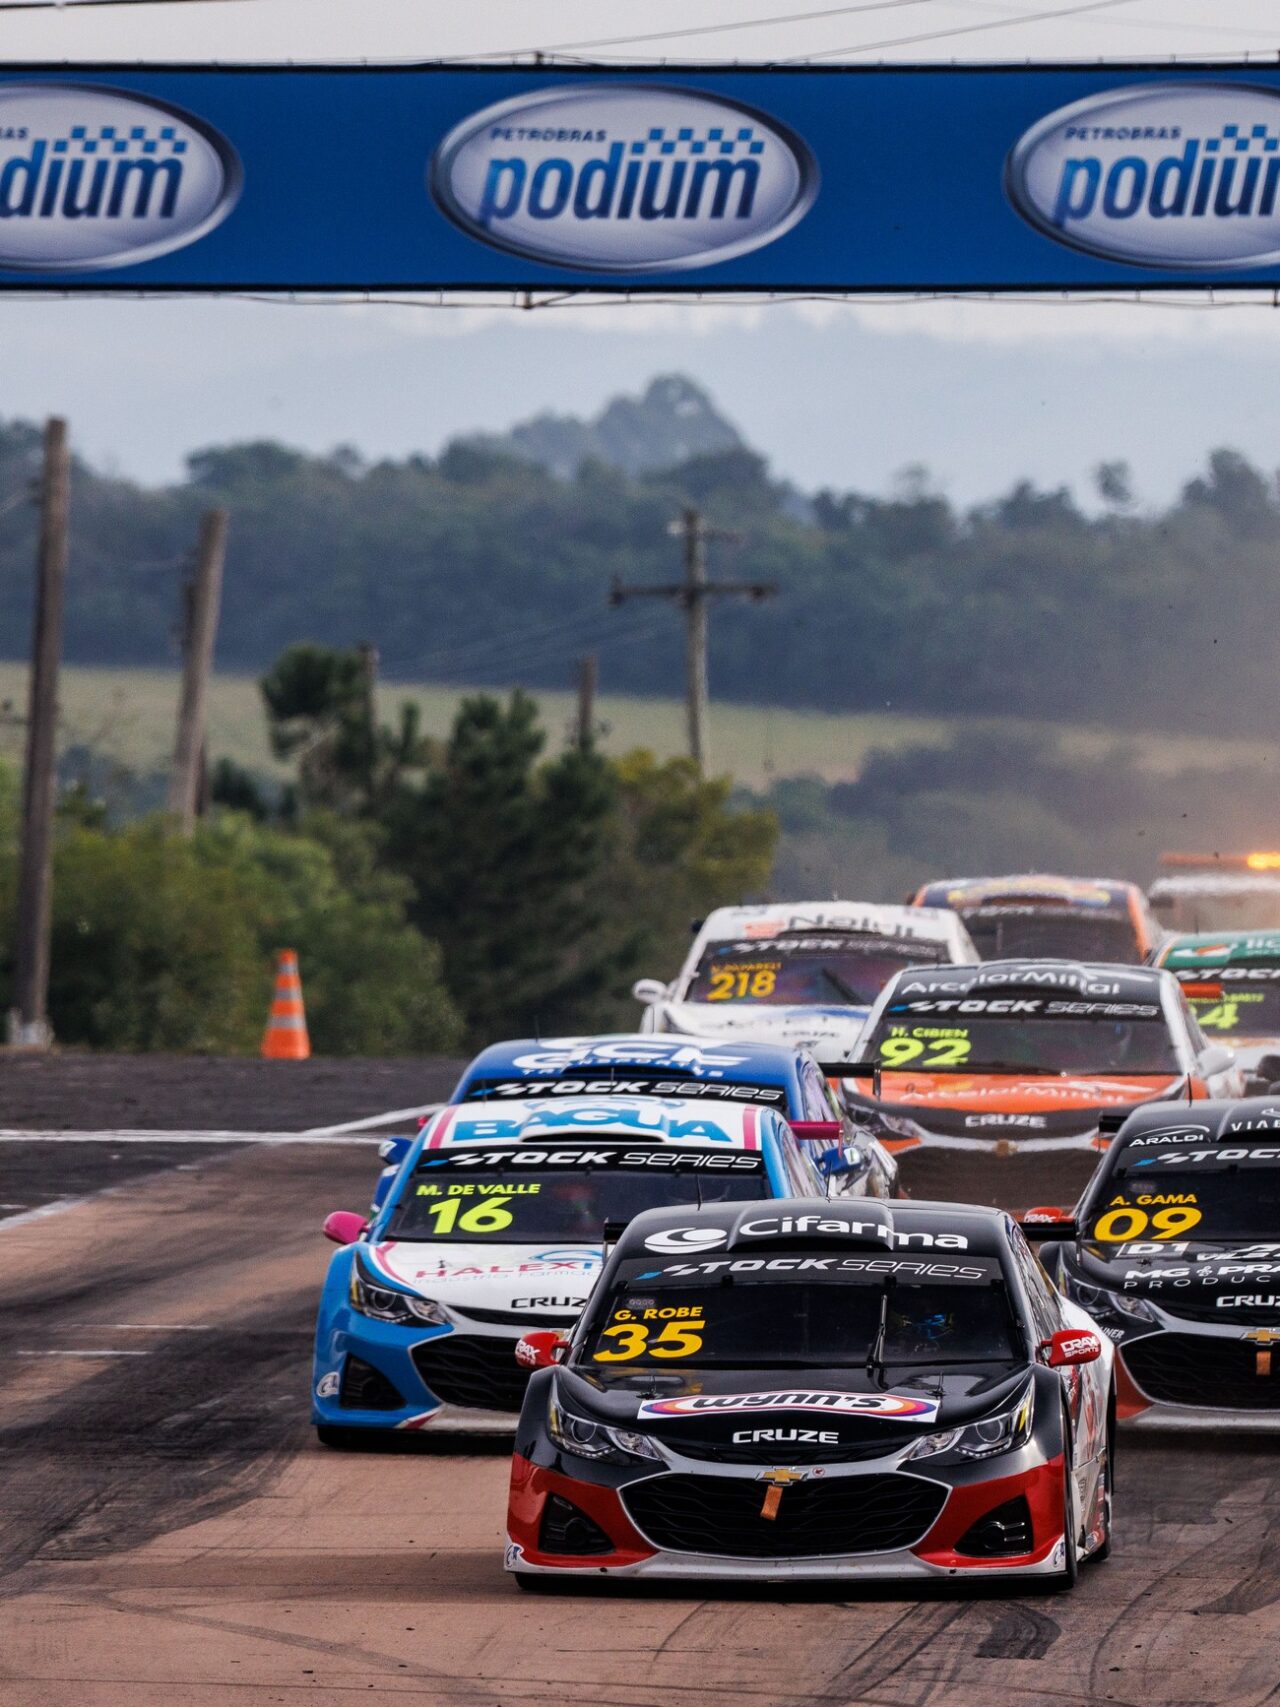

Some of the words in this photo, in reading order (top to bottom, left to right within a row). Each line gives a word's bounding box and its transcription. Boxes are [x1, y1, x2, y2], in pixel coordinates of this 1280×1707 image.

[491, 127, 606, 143] PETROBRAS
[1065, 126, 1181, 141] PETROBRAS
[0, 140, 186, 219] dium
[478, 141, 758, 226] podium
[706, 970, 777, 1000] 218
[902, 971, 1121, 996] ArcelorMittal
[889, 999, 1042, 1014] STOCK
[891, 1026, 909, 1038] H.
[913, 1026, 968, 1038] CIBIEN
[879, 1037, 972, 1067] 92
[469, 1080, 649, 1097] STOCK
[651, 1082, 784, 1101] SERIES
[965, 1114, 1048, 1129] CRUZE
[1129, 1133, 1204, 1148] ARALDI
[421, 1151, 621, 1168] STOCK
[618, 1152, 763, 1169] SERIES
[416, 1184, 442, 1196] M.
[448, 1184, 473, 1195] DE
[477, 1183, 541, 1195] VALLE
[1110, 1195, 1131, 1206] A.
[1134, 1193, 1197, 1205] GAMA
[428, 1197, 513, 1234] 16
[739, 1215, 969, 1250] Cifarma
[1094, 1207, 1202, 1242] 09
[636, 1258, 836, 1280] STOCK
[836, 1259, 987, 1279] SERIES
[1124, 1267, 1190, 1279] MG
[511, 1296, 588, 1309] CRUZ
[614, 1309, 637, 1321] G.
[643, 1306, 703, 1320] ROBE
[593, 1320, 706, 1363] 35
[732, 1428, 839, 1445] CRUZE
